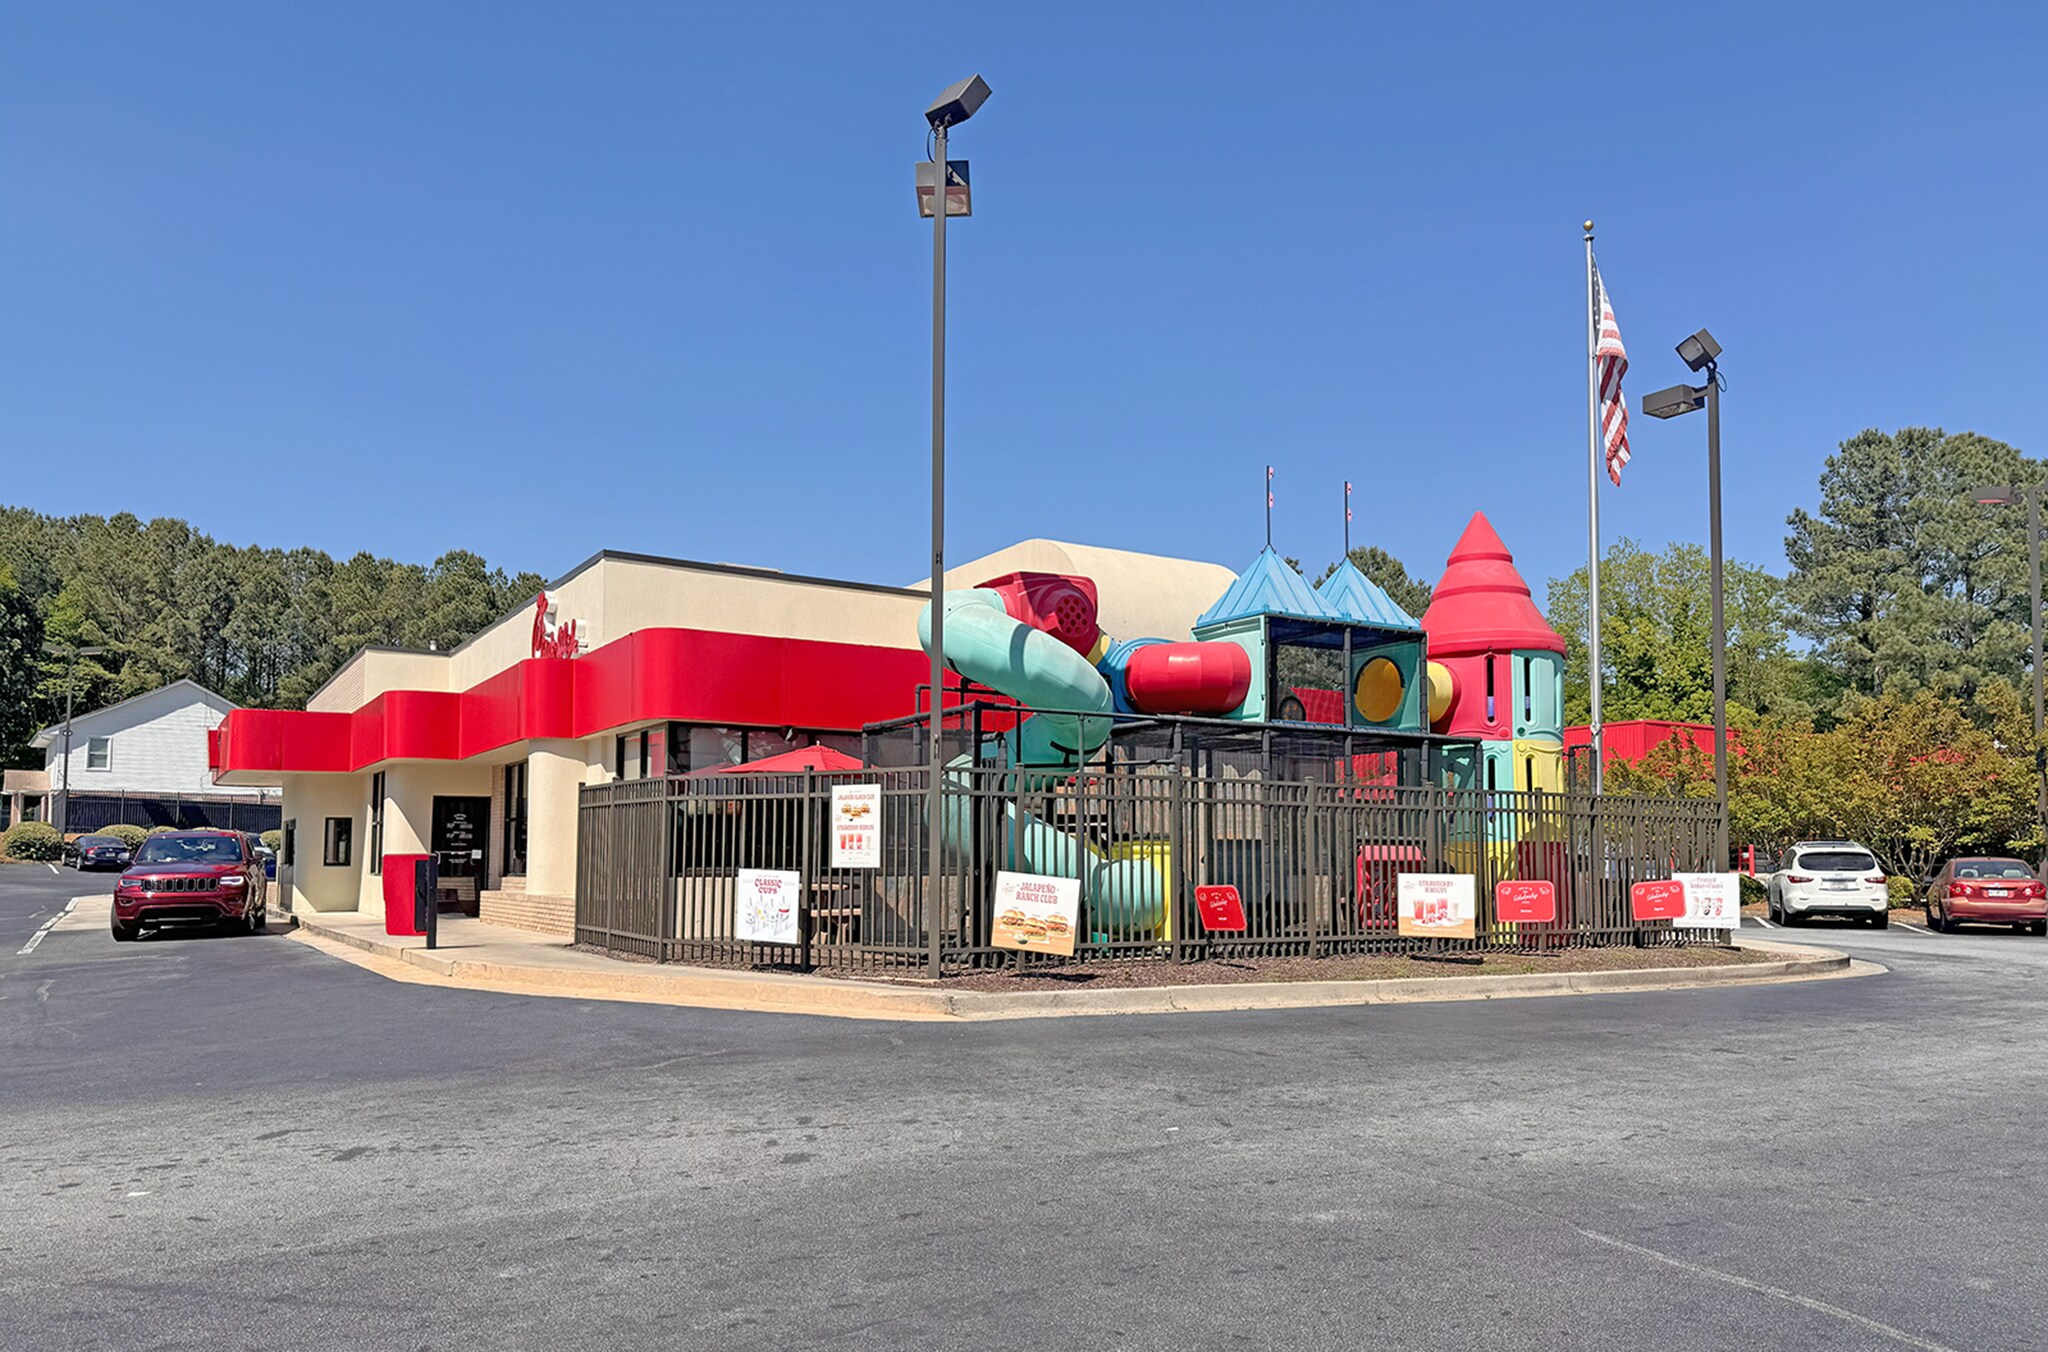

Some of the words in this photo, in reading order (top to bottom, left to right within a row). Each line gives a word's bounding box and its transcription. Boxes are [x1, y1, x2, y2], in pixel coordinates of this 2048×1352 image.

[754, 878, 783, 889] CLASSIC
[1020, 882, 1056, 894] JALAPEÑO
[758, 887, 778, 895] CUPS
[1016, 891, 1040, 903] RANCH
[1040, 894, 1058, 905] CLUB
